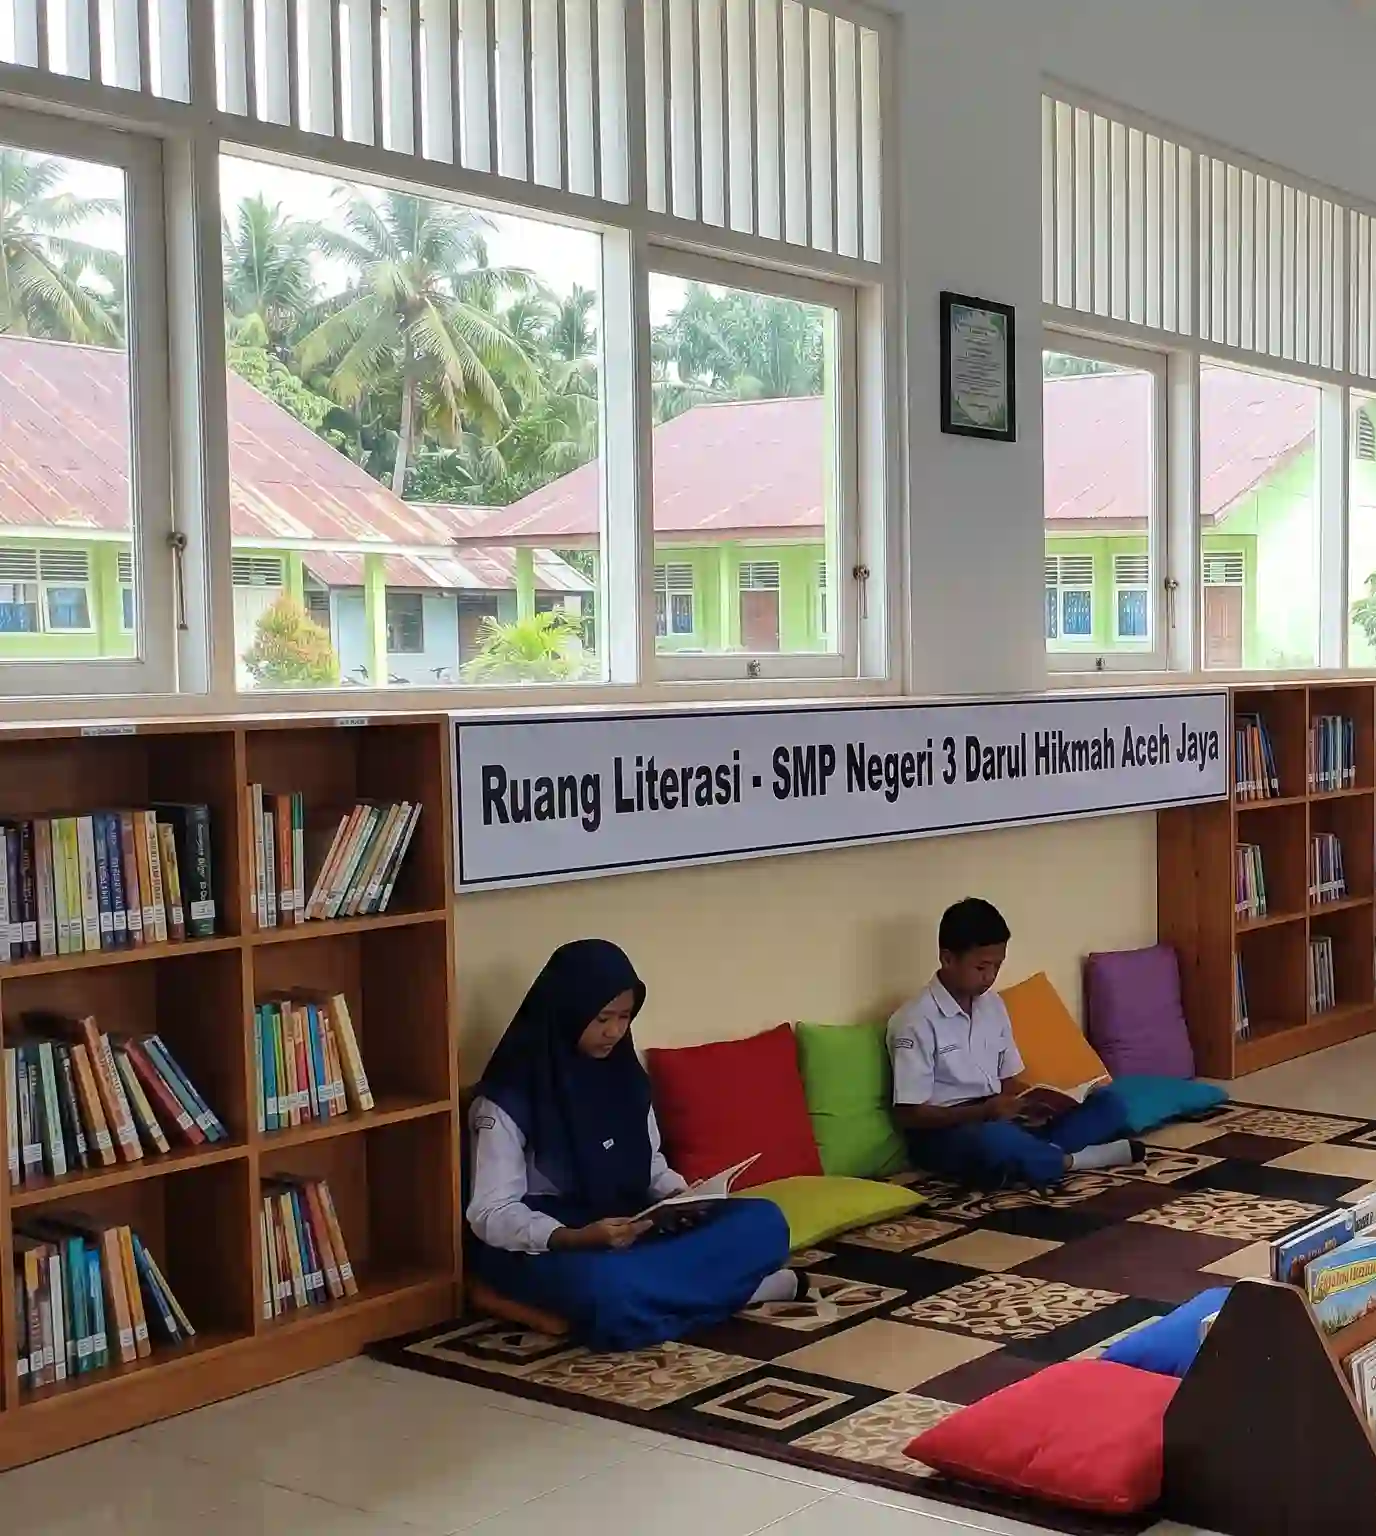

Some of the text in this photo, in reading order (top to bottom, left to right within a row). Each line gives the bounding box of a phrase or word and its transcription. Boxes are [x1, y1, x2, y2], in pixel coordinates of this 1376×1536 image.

[481, 764, 602, 833] Ruang
[614, 749, 741, 814] Literasi
[772, 744, 836, 800] SMP
[846, 738, 933, 804] Negeri
[942, 736, 957, 785] 3
[965, 732, 1027, 783] Darul
[1034, 727, 1115, 776] Hikmah
[1121, 723, 1170, 768] Aceh
[1175, 722, 1219, 772] Jaya
